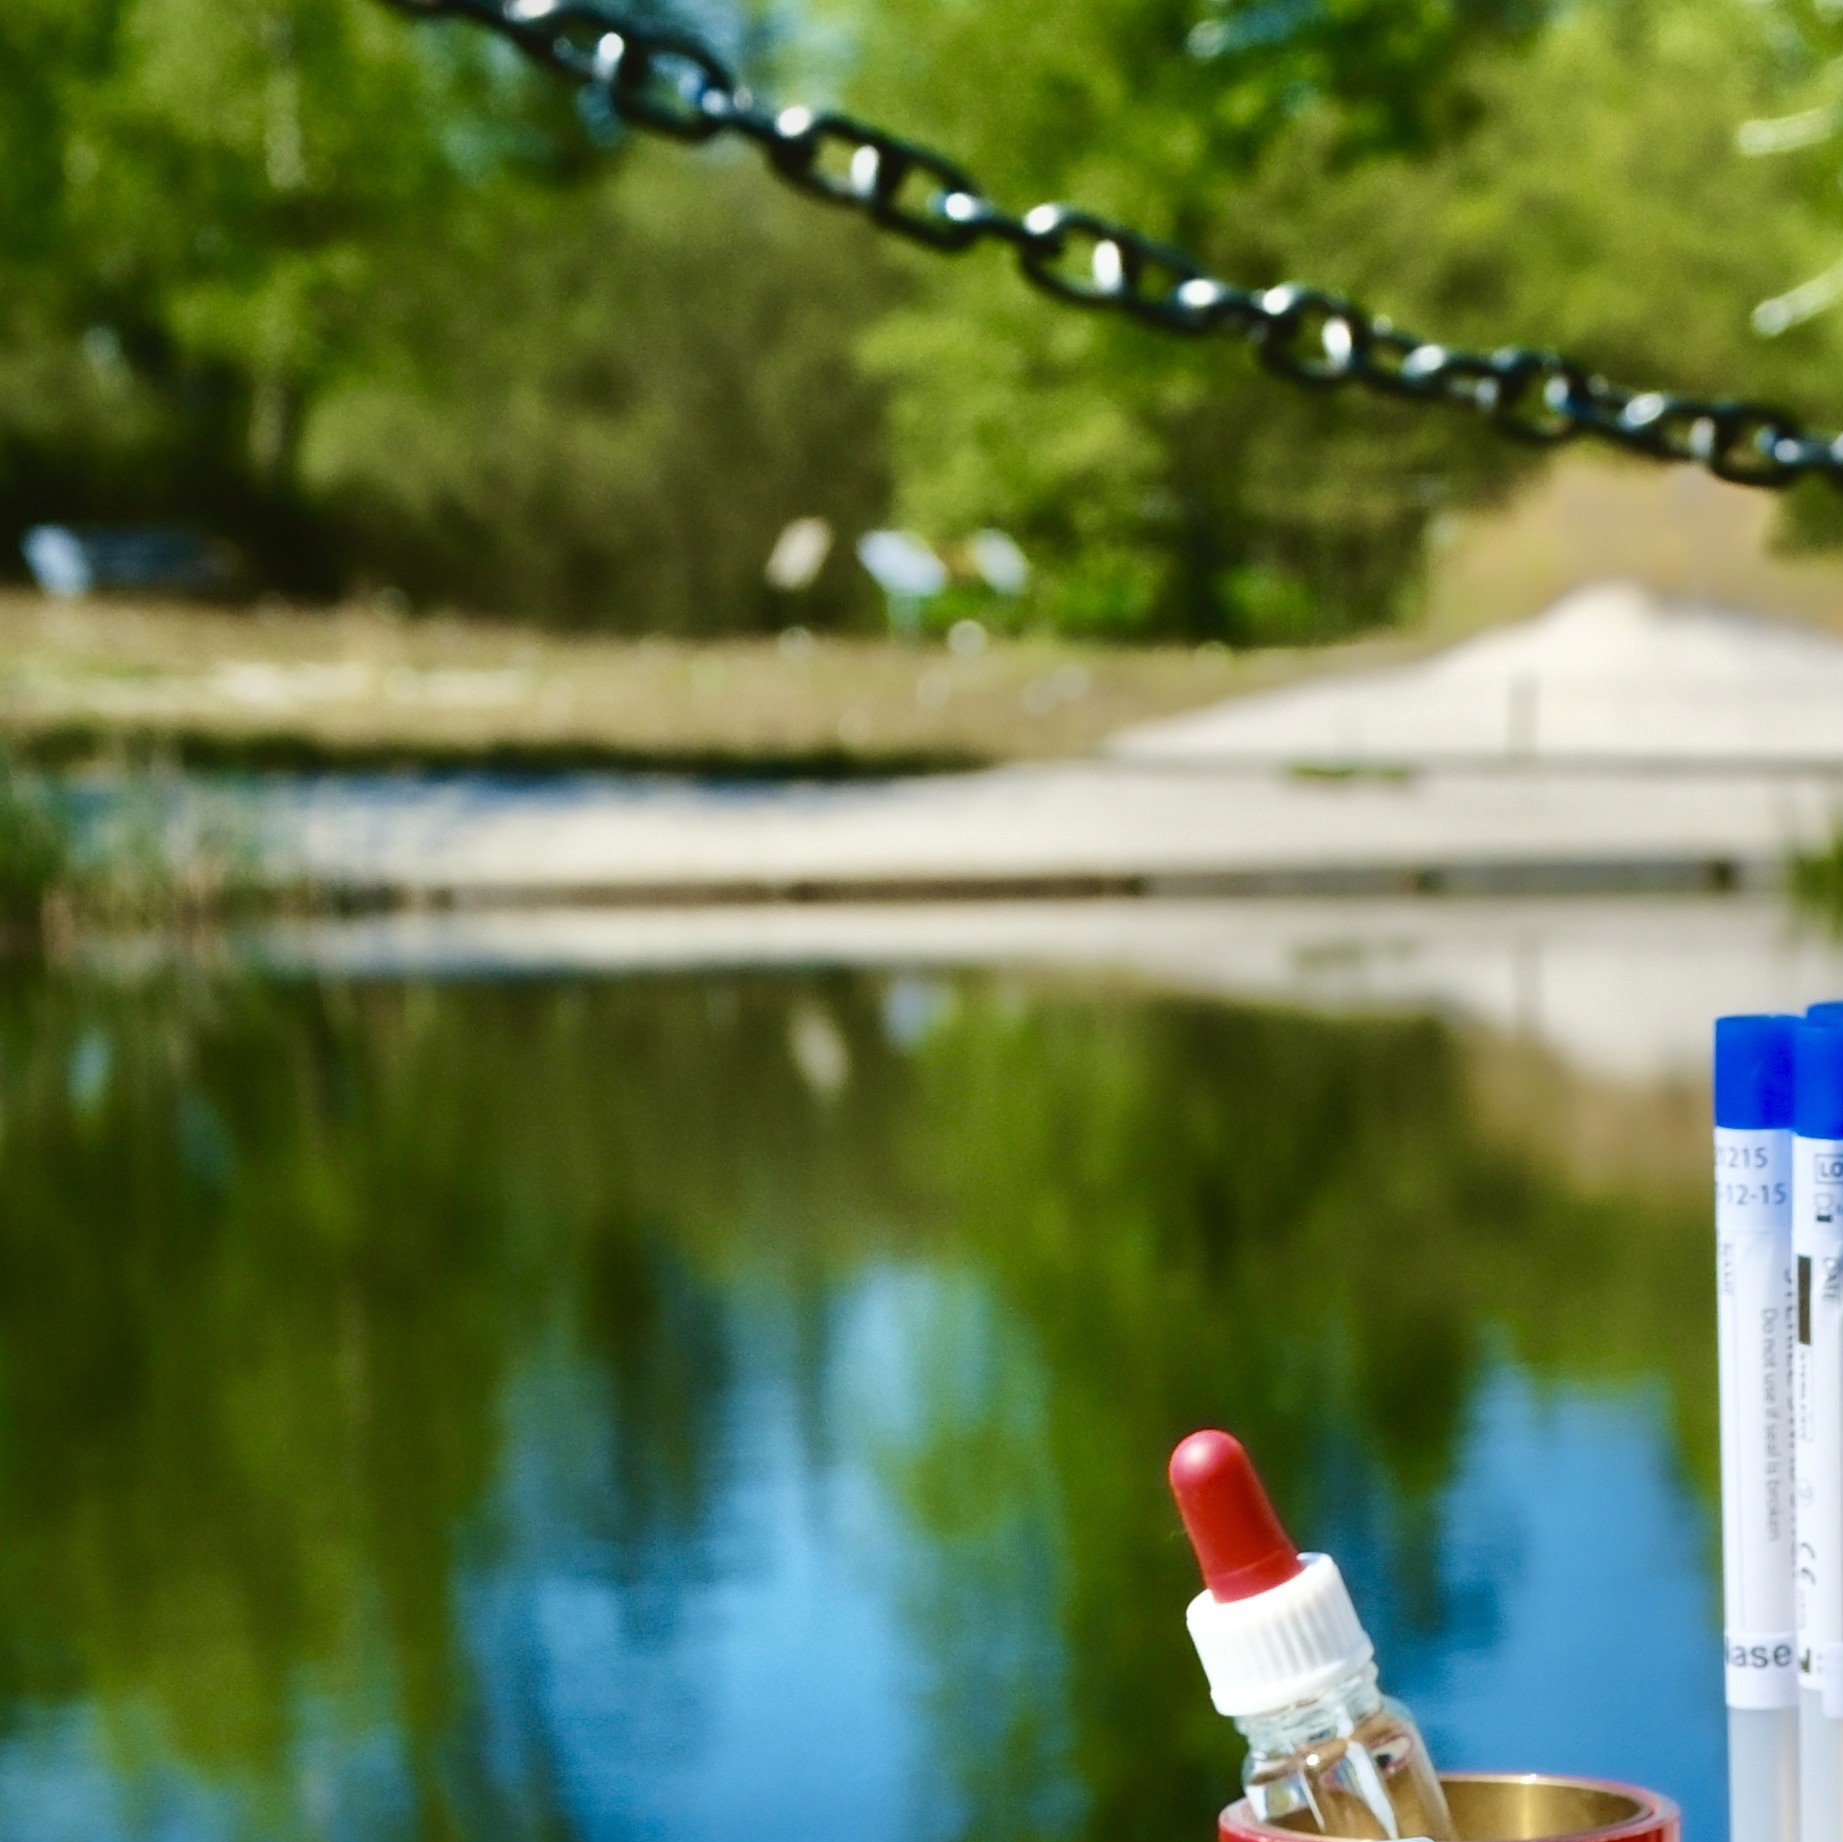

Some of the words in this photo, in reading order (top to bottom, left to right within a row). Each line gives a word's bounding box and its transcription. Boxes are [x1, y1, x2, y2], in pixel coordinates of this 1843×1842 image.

[1761, 1307, 1778, 1335] Do
[1763, 1338, 1778, 1369] not
[1764, 1372, 1776, 1402] use
[1766, 1424, 1783, 1458] seal
[1766, 1478, 1784, 1542] broken
